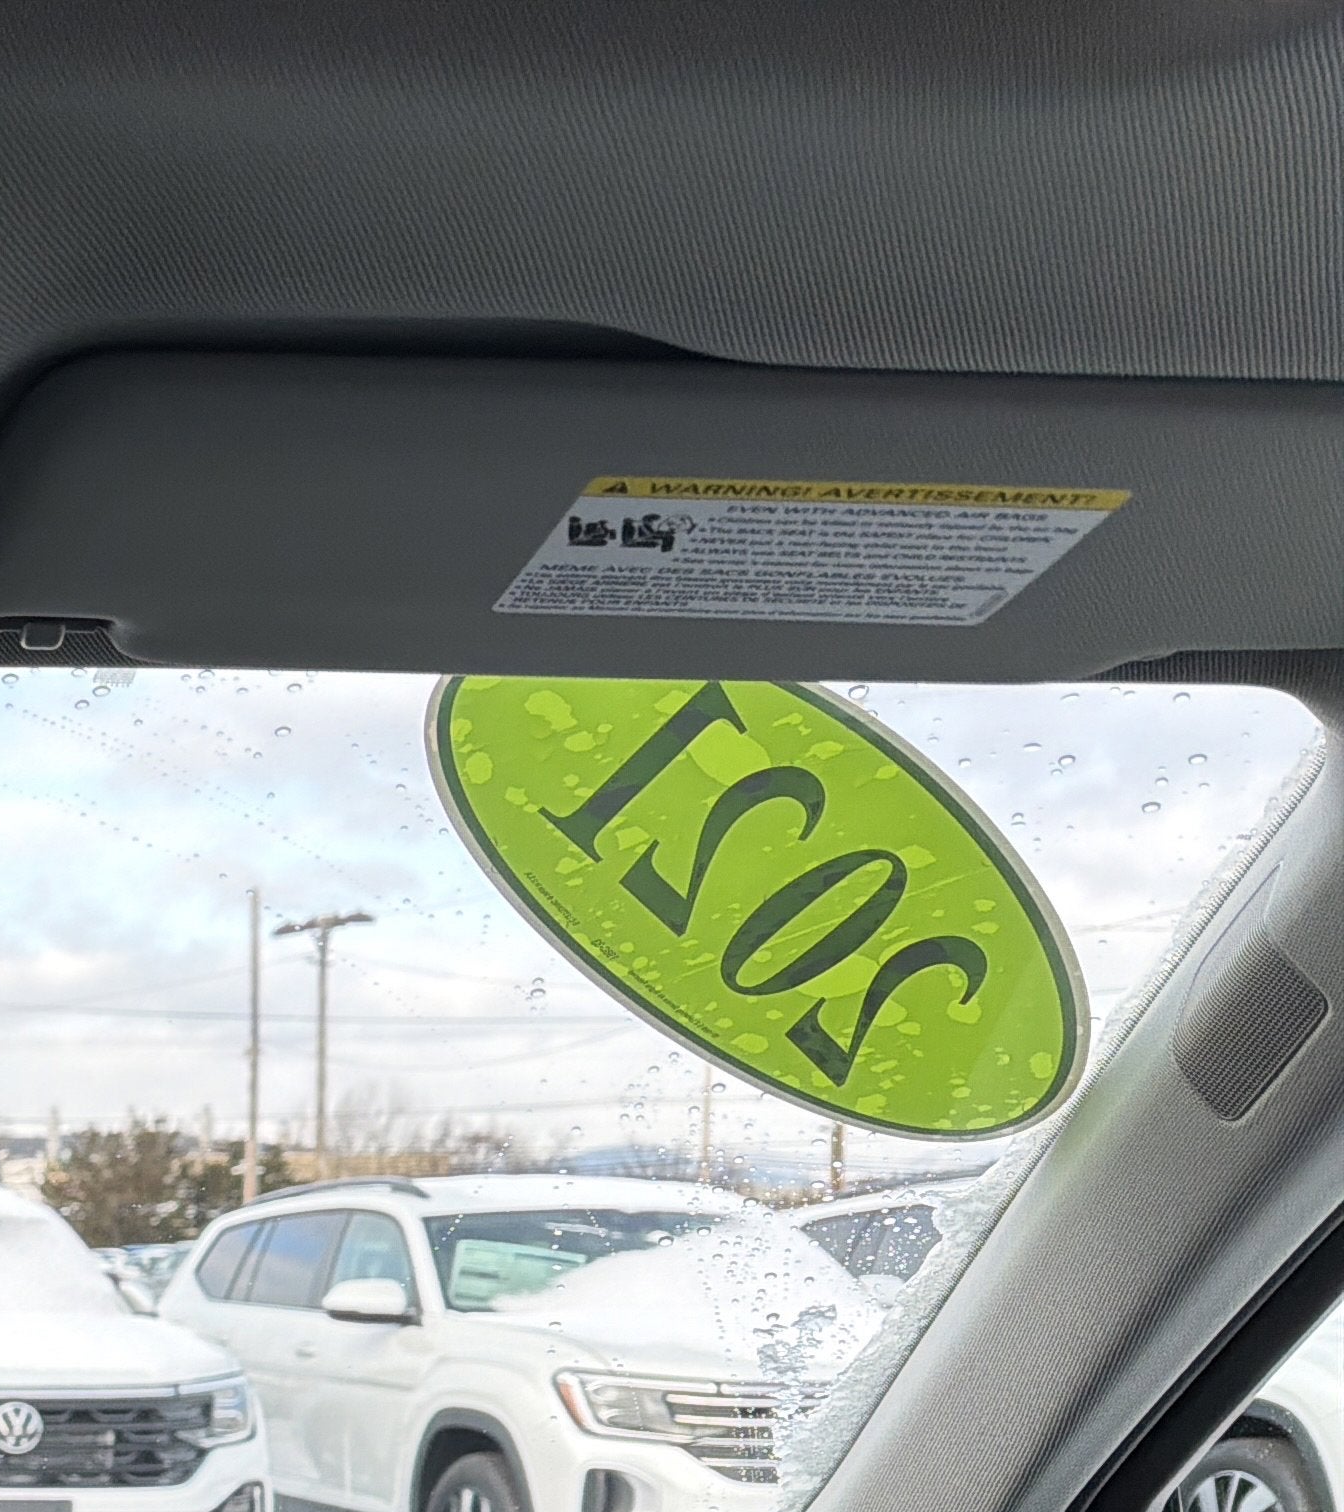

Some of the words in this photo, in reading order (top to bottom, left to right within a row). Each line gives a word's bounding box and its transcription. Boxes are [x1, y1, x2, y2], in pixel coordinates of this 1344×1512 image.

[650, 482, 812, 497] WARNING!
[816, 486, 1098, 505] AVERTISSEMENT!
[726, 505, 778, 515] EVEN
[784, 506, 837, 516] WITH
[842, 508, 951, 519] ADVANCED
[954, 511, 990, 520] AIR
